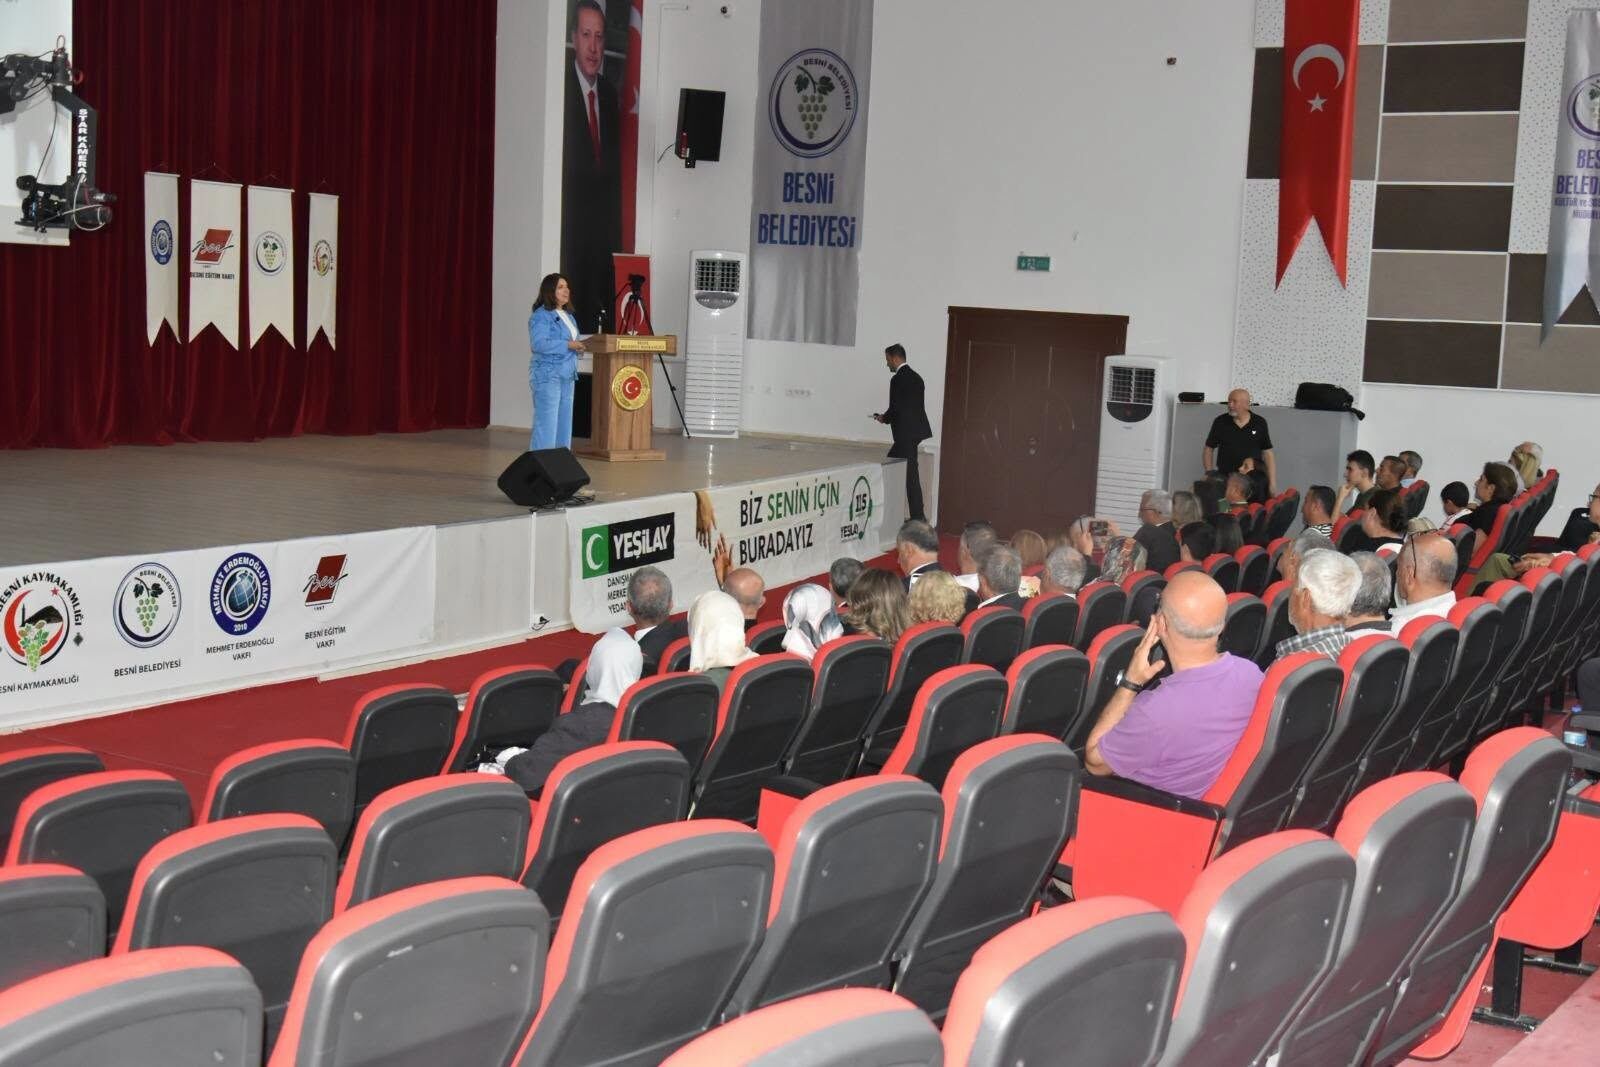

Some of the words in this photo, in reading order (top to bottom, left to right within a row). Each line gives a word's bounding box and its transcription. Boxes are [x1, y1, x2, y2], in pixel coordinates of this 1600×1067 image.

[78, 108, 88, 134] STAR
[1576, 149, 1600, 169] BES
[783, 171, 834, 204] BESNİ
[1556, 175, 1600, 195] BELED
[757, 213, 856, 248] BELEDİYESİ
[740, 490, 763, 527] BİZ
[767, 481, 809, 521] SENİN
[813, 476, 840, 516] İÇİN
[613, 524, 671, 560] YEŞİLAY
[740, 523, 813, 566] BURADAYIZ
[213, 571, 225, 615] MEHMET
[223, 556, 266, 578] ERDEMOĞLU
[260, 580, 269, 609] VAKFI
[607, 588, 627, 601] MERKE
[23, 571, 84, 626] KAYMAKAMLIĞI
[233, 622, 248, 632] 2010
[304, 629, 324, 640] BESNİ
[324, 625, 347, 637] EĞİTİM
[206, 643, 234, 655] MEHMET
[235, 636, 275, 650] ERDEMOĞLU
[316, 639, 336, 649] VAKFI
[232, 651, 252, 661] VAKFI
[114, 665, 137, 677] BESNİ
[138, 658, 181, 674] BELEDİYESİ
[17, 674, 80, 692] KAYMAKAMLIĞI
